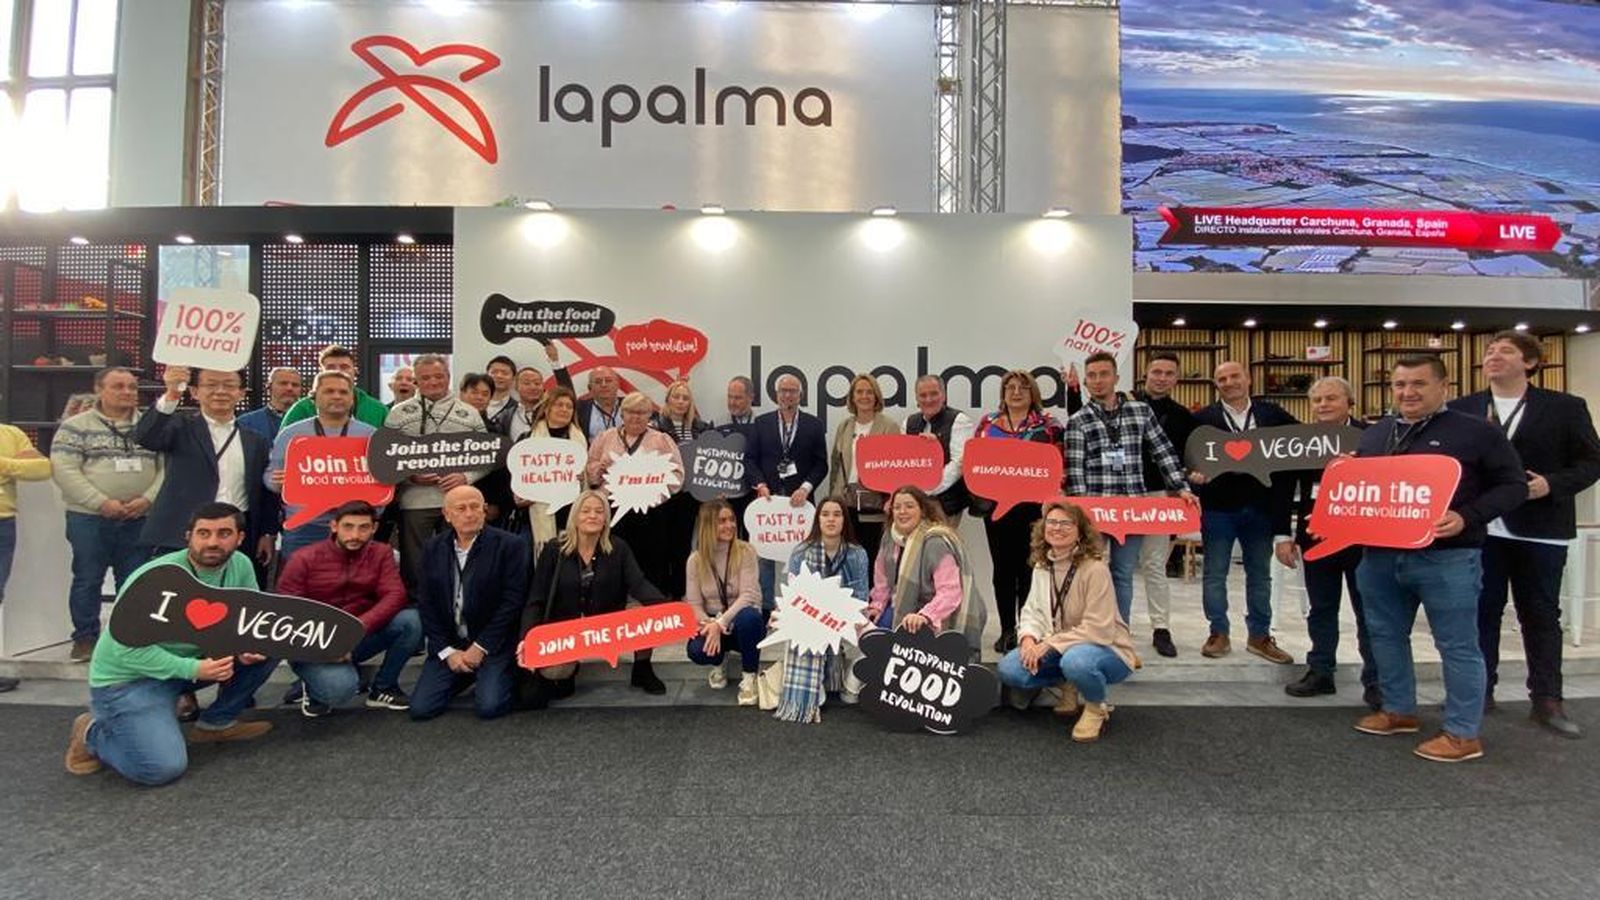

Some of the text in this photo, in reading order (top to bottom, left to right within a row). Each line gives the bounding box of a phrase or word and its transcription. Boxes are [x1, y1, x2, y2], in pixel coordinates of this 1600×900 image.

[539, 65, 832, 148] lapalma
[1194, 215, 1449, 229] LIVE Headquarter Carchuna, Granada, Spain
[1194, 225, 1237, 234] DIRECTO
[1294, 227, 1331, 235] centrales
[1332, 227, 1375, 236] Carchuna,
[1376, 228, 1414, 237] Granada,
[1499, 225, 1537, 240] LIVE
[175, 304, 246, 335] 100%
[496, 307, 601, 320] Join the food
[504, 320, 597, 334] revolution!
[1074, 319, 1126, 348] 100%
[167, 332, 241, 354] natural
[1064, 338, 1118, 358] natul
[386, 437, 501, 456] Join the food
[1205, 434, 1341, 461] I VEGAN
[298, 454, 369, 473] Join th
[396, 451, 497, 471] revolution!
[520, 453, 562, 467] TASTY
[693, 455, 745, 480] FOOD
[864, 458, 933, 470] #IMPARABLES
[301, 474, 329, 485] food
[521, 469, 574, 484] HEALTHY
[618, 472, 666, 486] I'm in!
[972, 464, 1050, 479] #IMPARABLES
[1328, 480, 1432, 505] Join the
[756, 512, 793, 526] TASTY
[1090, 507, 1188, 523] THE FLAVOUR
[1328, 503, 1430, 520] food revolution
[757, 529, 805, 544] HEALTHY
[150, 591, 337, 650] I VEGAN
[791, 595, 847, 632] I'm in!
[539, 614, 685, 656] JOIN THE FLAVOUR
[891, 643, 967, 679] UNSTOPPABLE
[883, 658, 962, 707] FOOD
[879, 690, 953, 726] REVOLUTION
